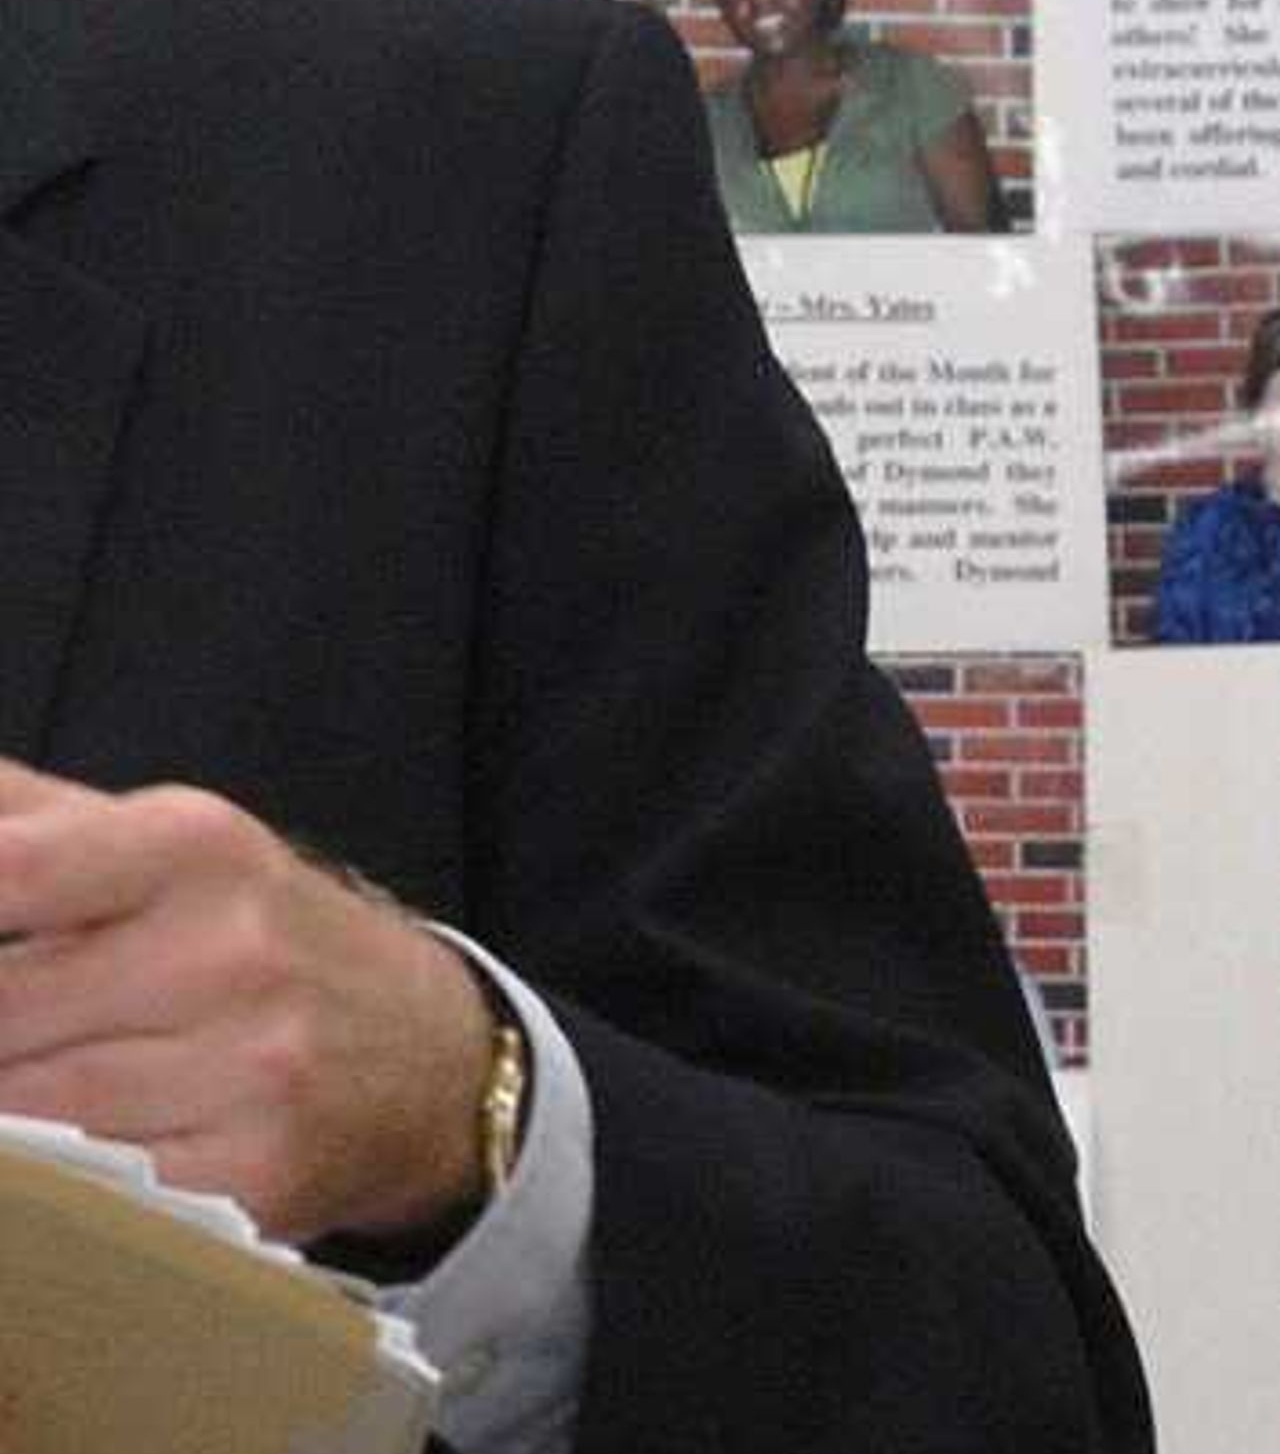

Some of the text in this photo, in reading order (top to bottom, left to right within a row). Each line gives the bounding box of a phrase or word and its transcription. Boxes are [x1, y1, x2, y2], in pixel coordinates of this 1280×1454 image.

[800, 294, 858, 321] Mrs.
[867, 294, 937, 321] Yates
[845, 359, 872, 382] of
[878, 360, 917, 382] the
[929, 360, 1011, 383] Month
[1018, 360, 1056, 382] for
[857, 430, 944, 454] perfect
